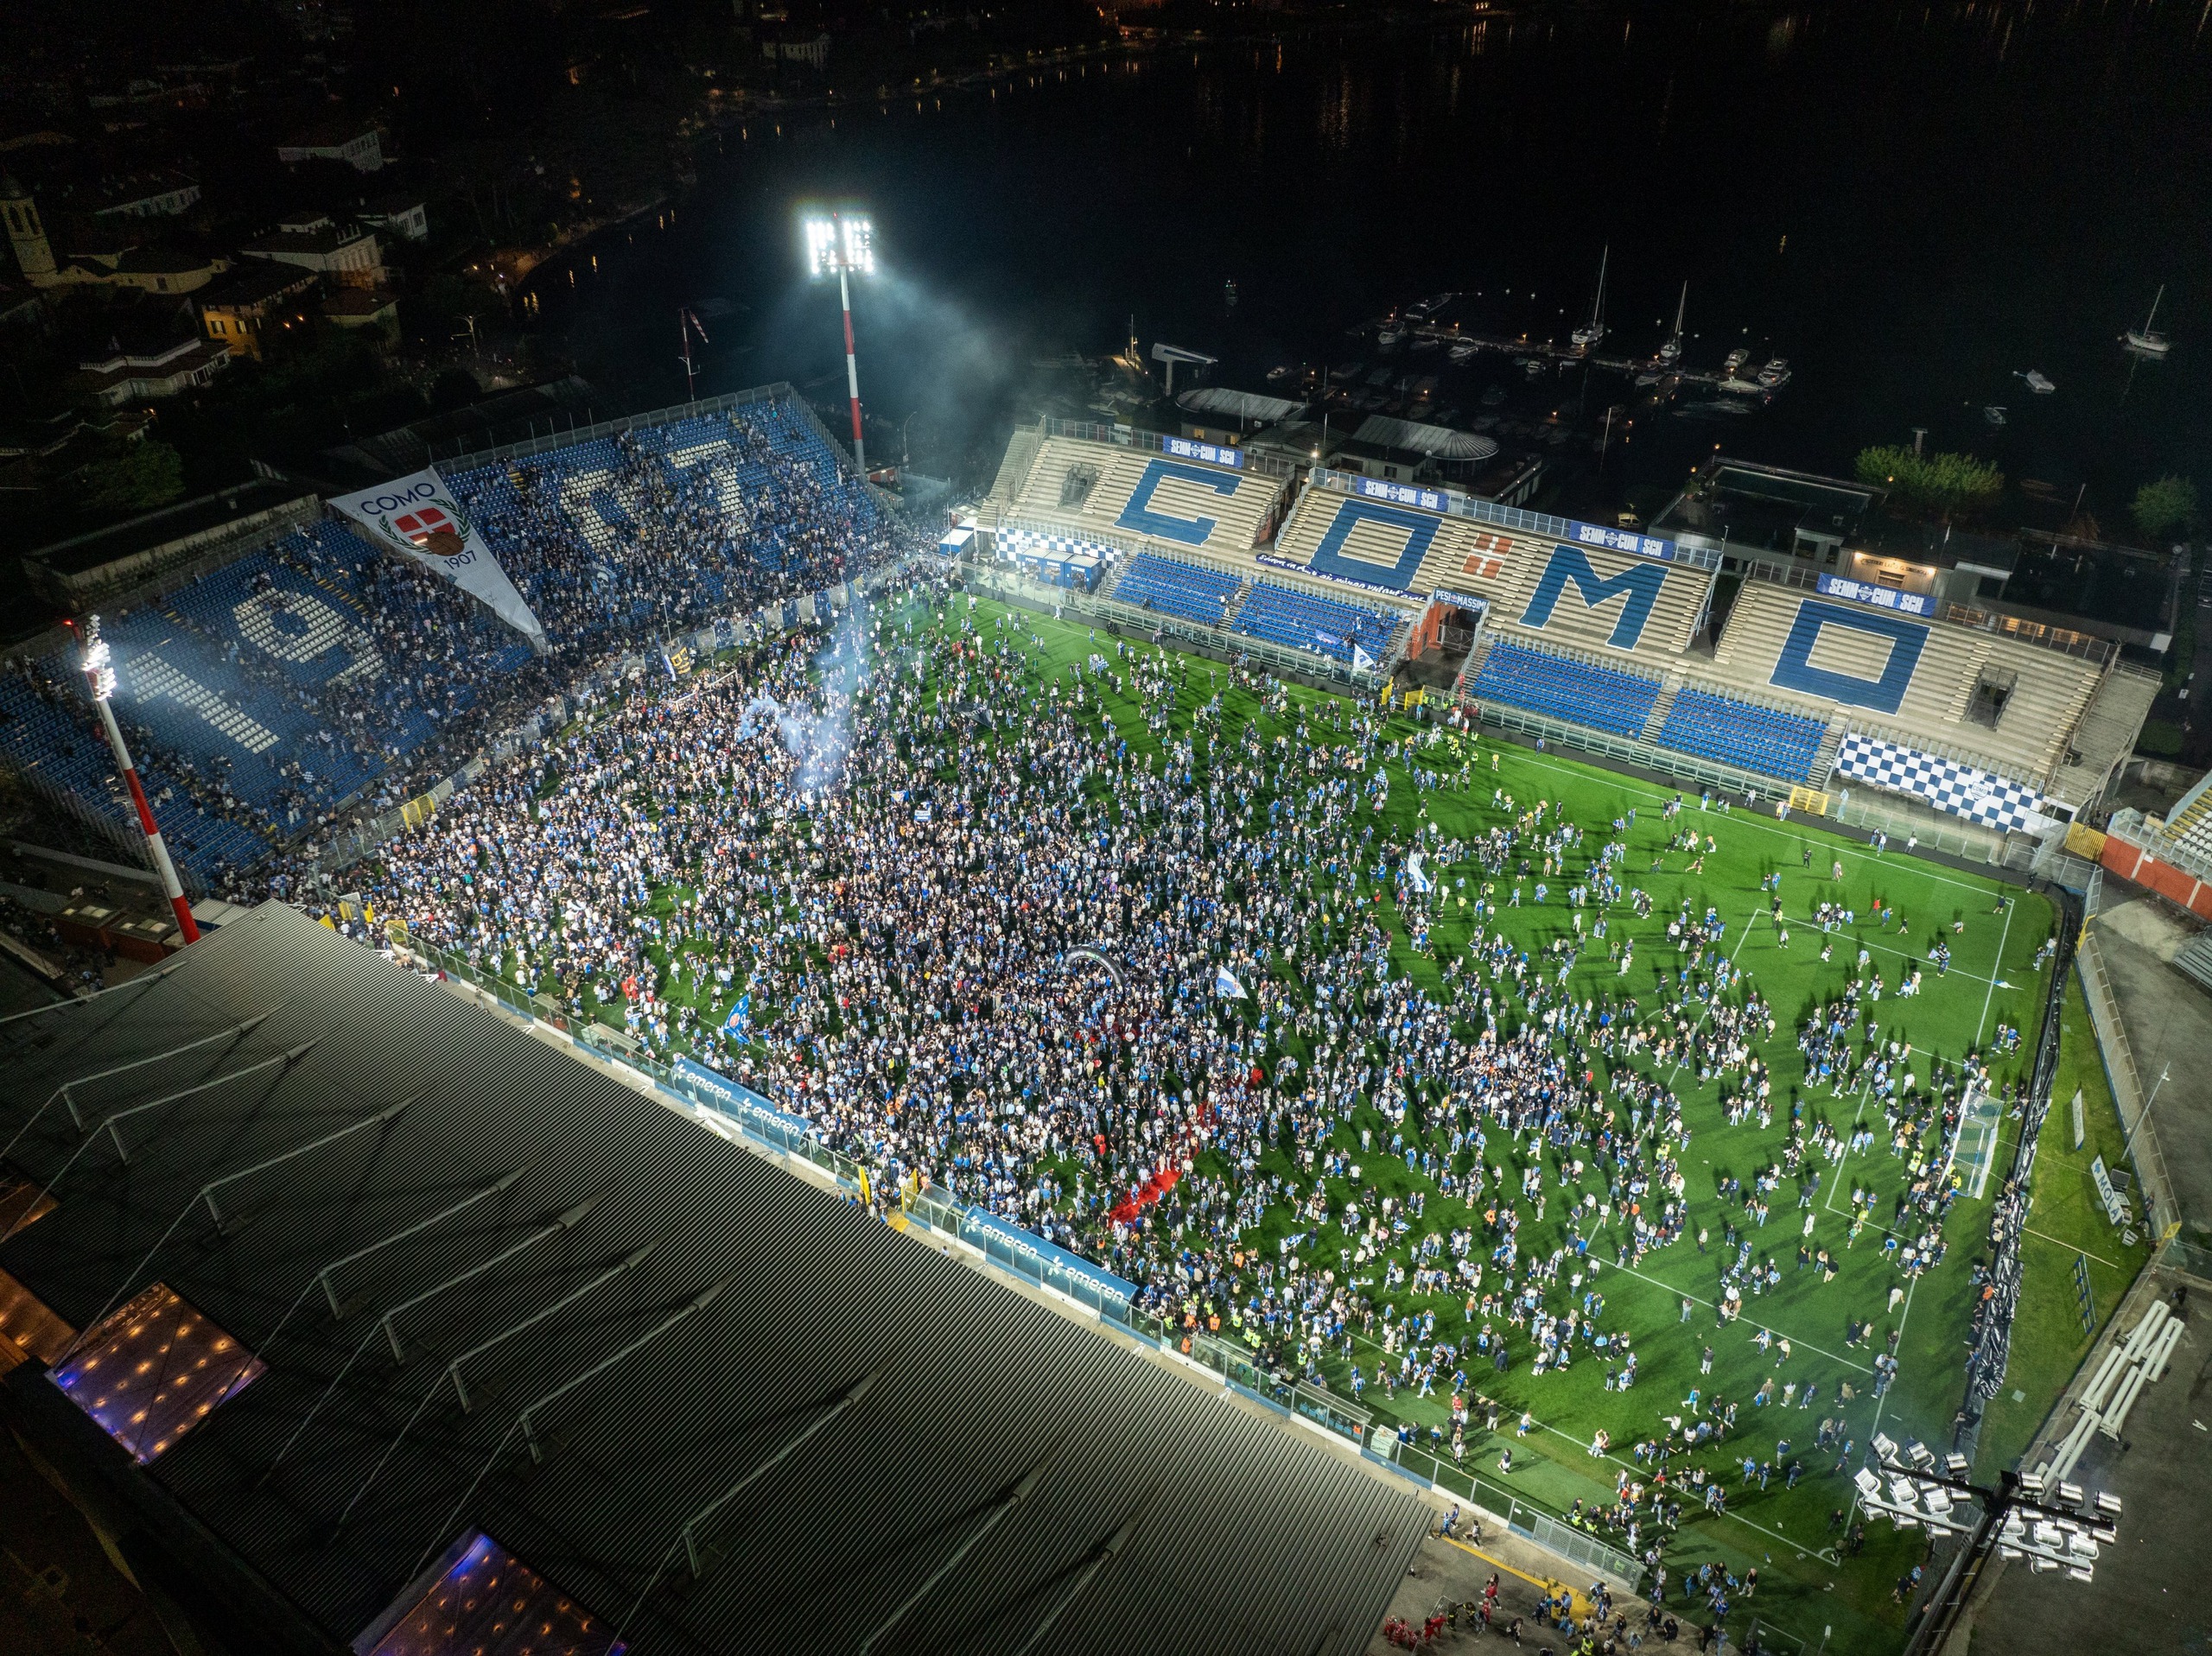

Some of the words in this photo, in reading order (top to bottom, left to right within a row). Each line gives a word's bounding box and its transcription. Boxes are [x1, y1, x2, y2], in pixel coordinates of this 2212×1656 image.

[1170, 439, 1192, 457] SEMM
[360, 482, 435, 515] COMO
[1364, 480, 1389, 498] SEMM
[1579, 525, 1606, 545] SEMM
[443, 549, 477, 570] 1907
[1435, 589, 1452, 602] PESI
[1827, 578, 1860, 599] SEMM
[686, 1072, 732, 1101] emeren
[753, 1106, 800, 1137] emeren
[2097, 1174, 2120, 1220] MOLA
[982, 1224, 1038, 1259] emeren
[1065, 1266, 1125, 1304] emeren
